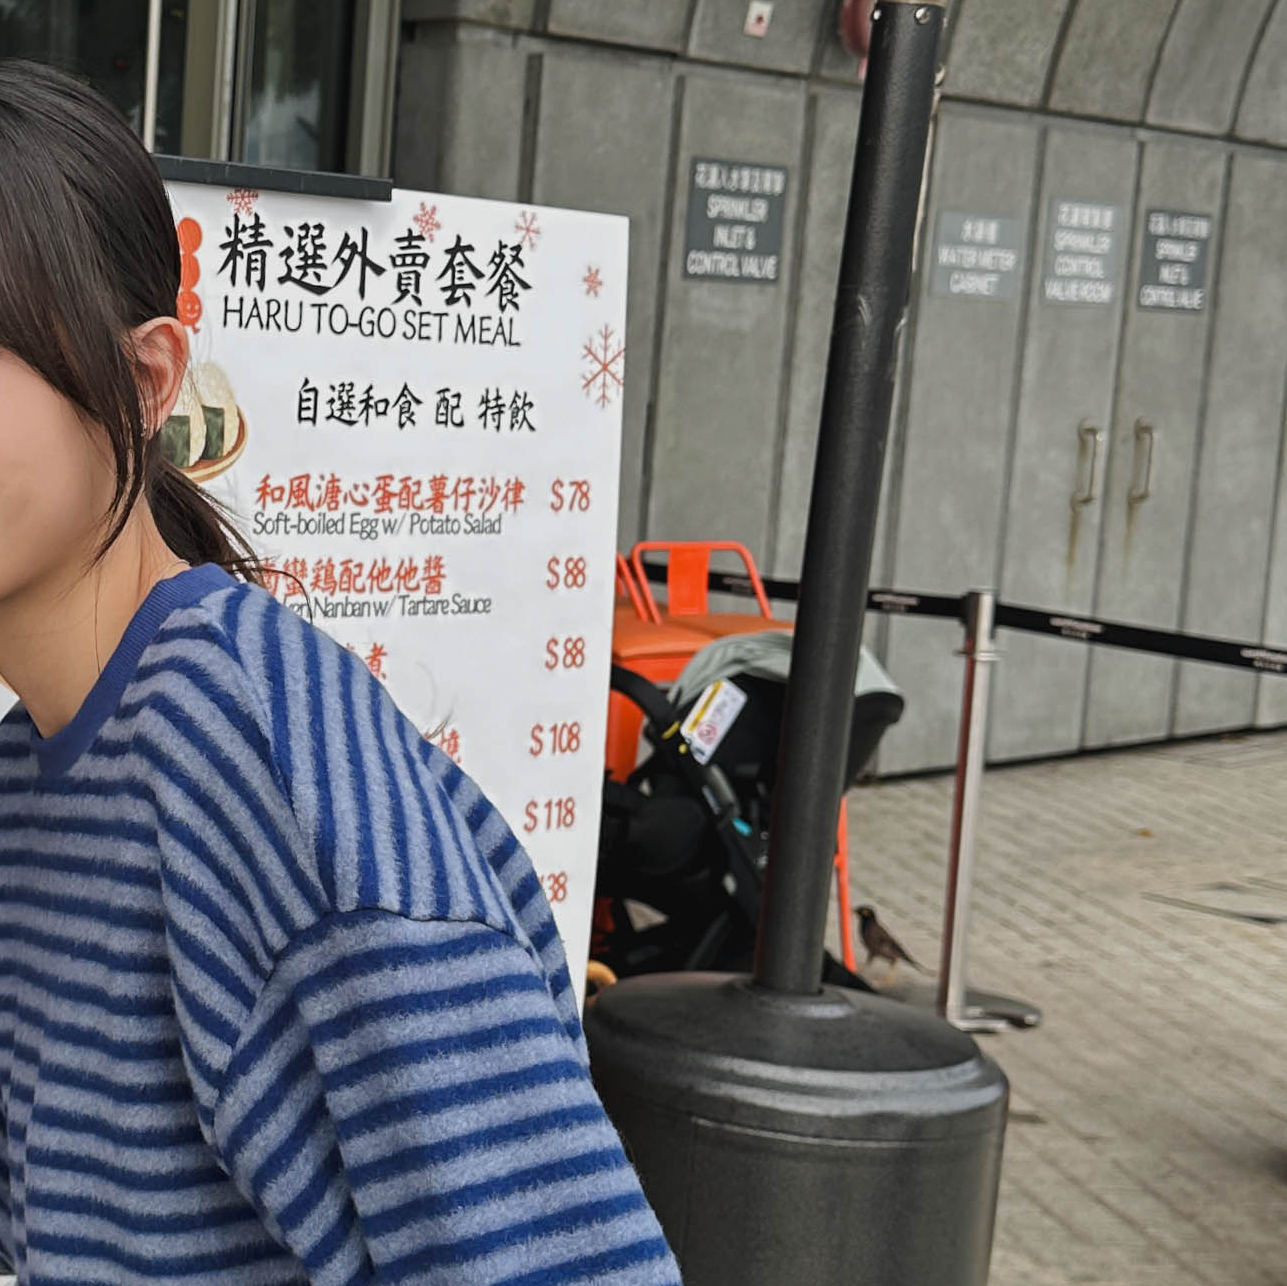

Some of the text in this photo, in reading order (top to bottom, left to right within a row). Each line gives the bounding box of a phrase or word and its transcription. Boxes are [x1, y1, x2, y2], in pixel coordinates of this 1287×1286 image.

[706, 193, 768, 223] SPRINKLER
[217, 212, 533, 313] 精選外賣套餐
[687, 250, 778, 280] CONTROL VALVE
[938, 245, 976, 268] WATER
[223, 295, 522, 348] HARU TO-GO SET MEAL
[435, 387, 465, 429] 配
[478, 387, 537, 434] 特飲
[253, 511, 502, 541] Soft-boiled Egg w/ Potato Salad
[546, 556, 587, 589] $88
[314, 596, 371, 618] Nanban
[373, 595, 397, 617] w/
[397, 594, 450, 617] Tartare
[451, 594, 491, 615] Sauce
[544, 637, 586, 671] $88
[530, 722, 581, 757] $108
[523, 796, 576, 834] $118
